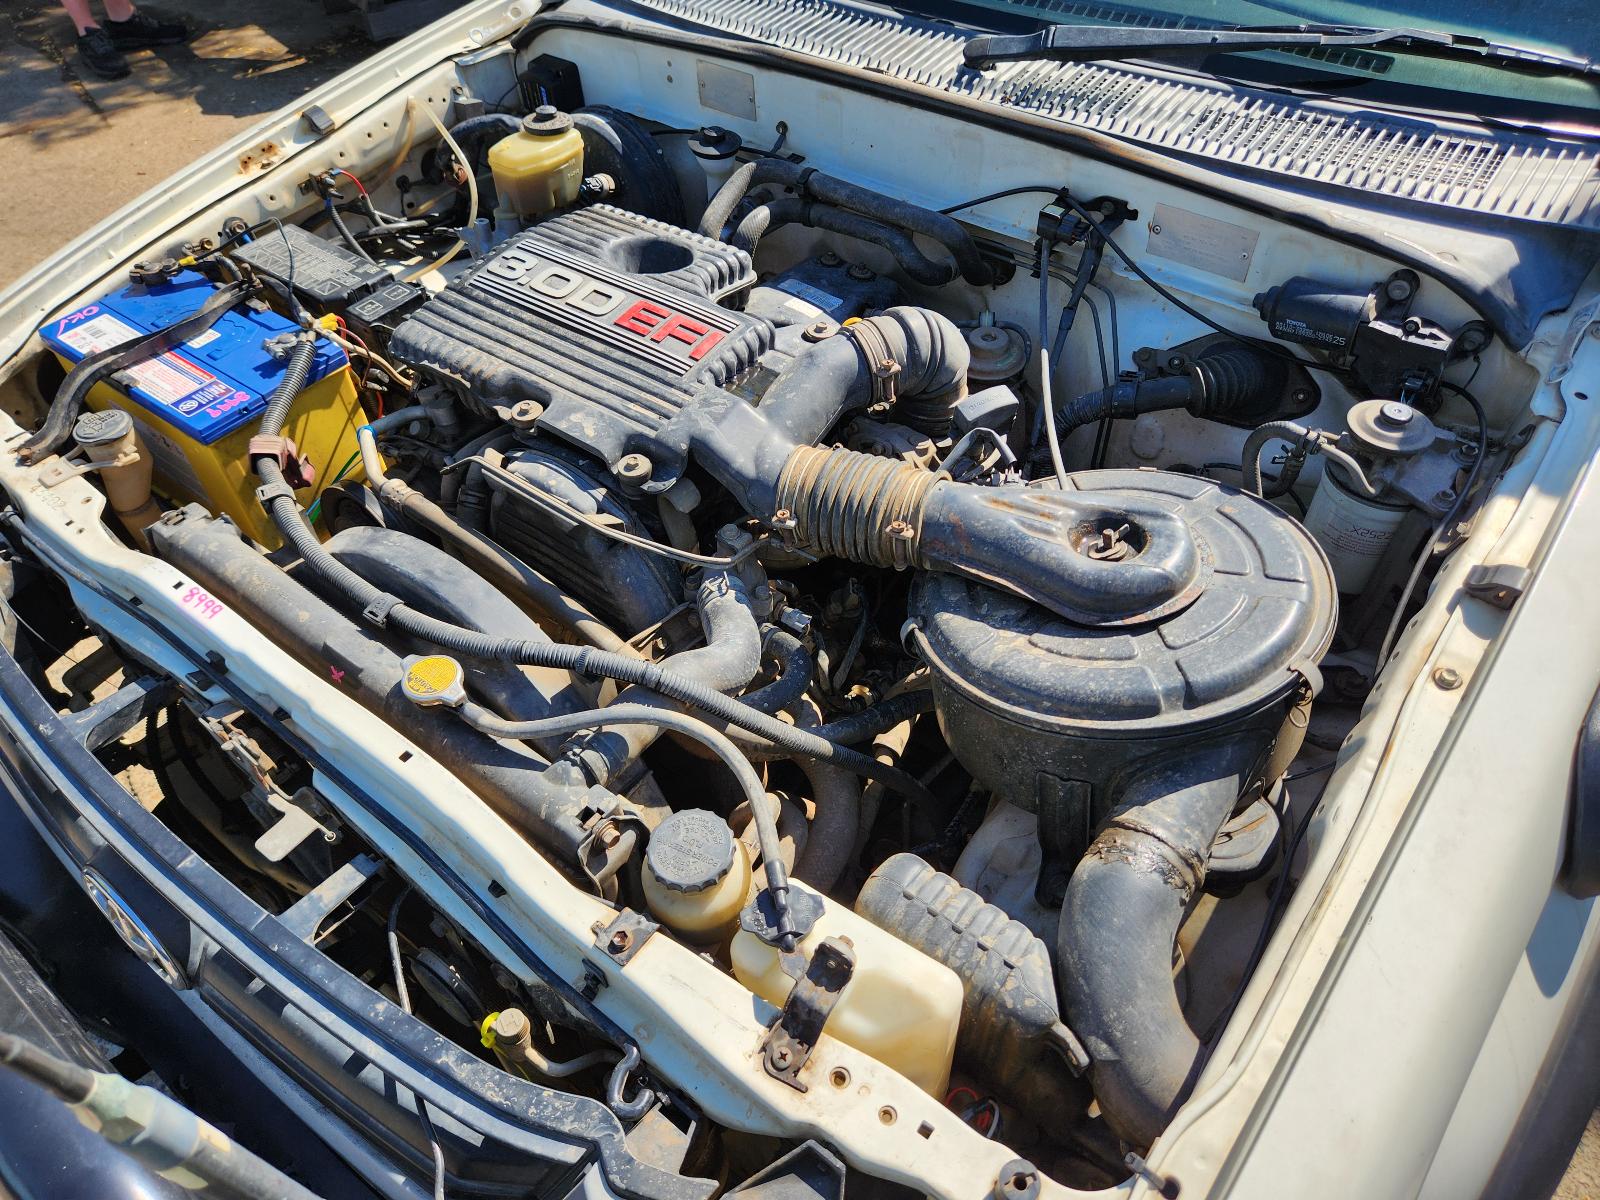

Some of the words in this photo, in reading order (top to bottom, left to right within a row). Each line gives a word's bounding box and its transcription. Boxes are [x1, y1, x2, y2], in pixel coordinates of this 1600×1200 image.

[486, 251, 625, 316] 3.0D
[614, 300, 725, 361] EFI
[1286, 319, 1307, 328] TOYOTA
[182, 586, 224, 619] 8999
[691, 848, 720, 867] POWER
